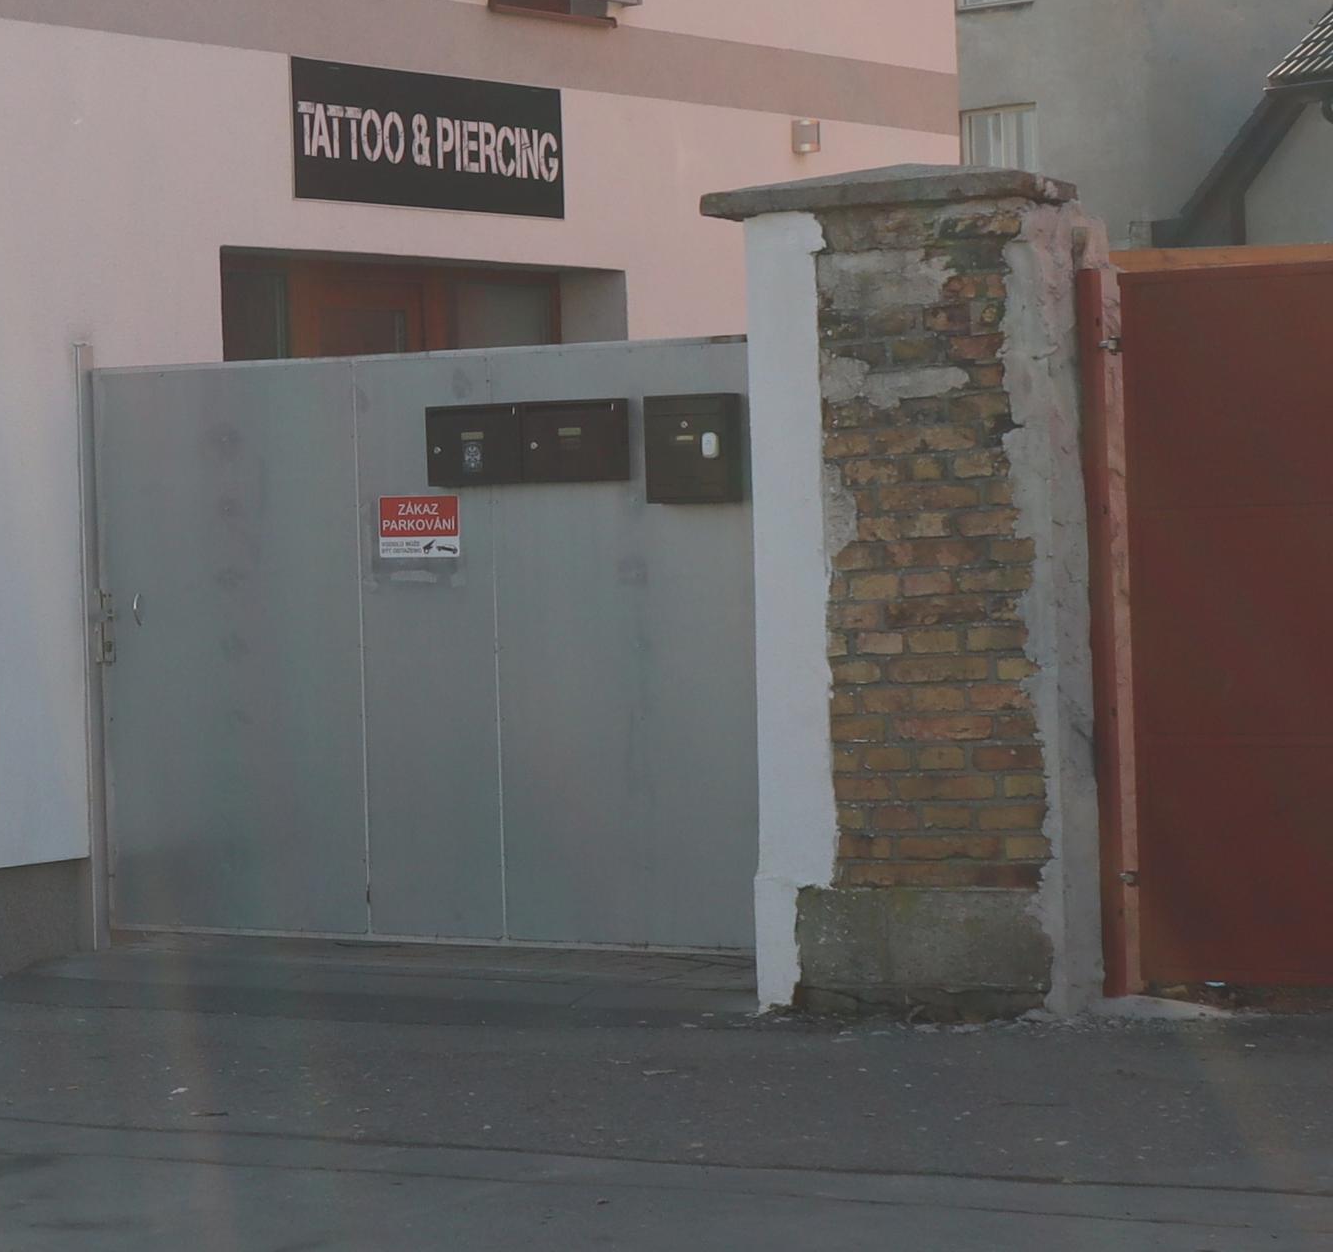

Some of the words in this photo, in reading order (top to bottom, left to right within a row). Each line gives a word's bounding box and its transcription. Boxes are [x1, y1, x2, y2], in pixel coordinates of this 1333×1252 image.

[297, 100, 405, 165] TATTOO
[411, 113, 432, 167] &
[436, 116, 559, 183] PIERCING
[397, 501, 440, 516] ZÁKAZ
[382, 515, 455, 532] PARKOVÁNÍ
